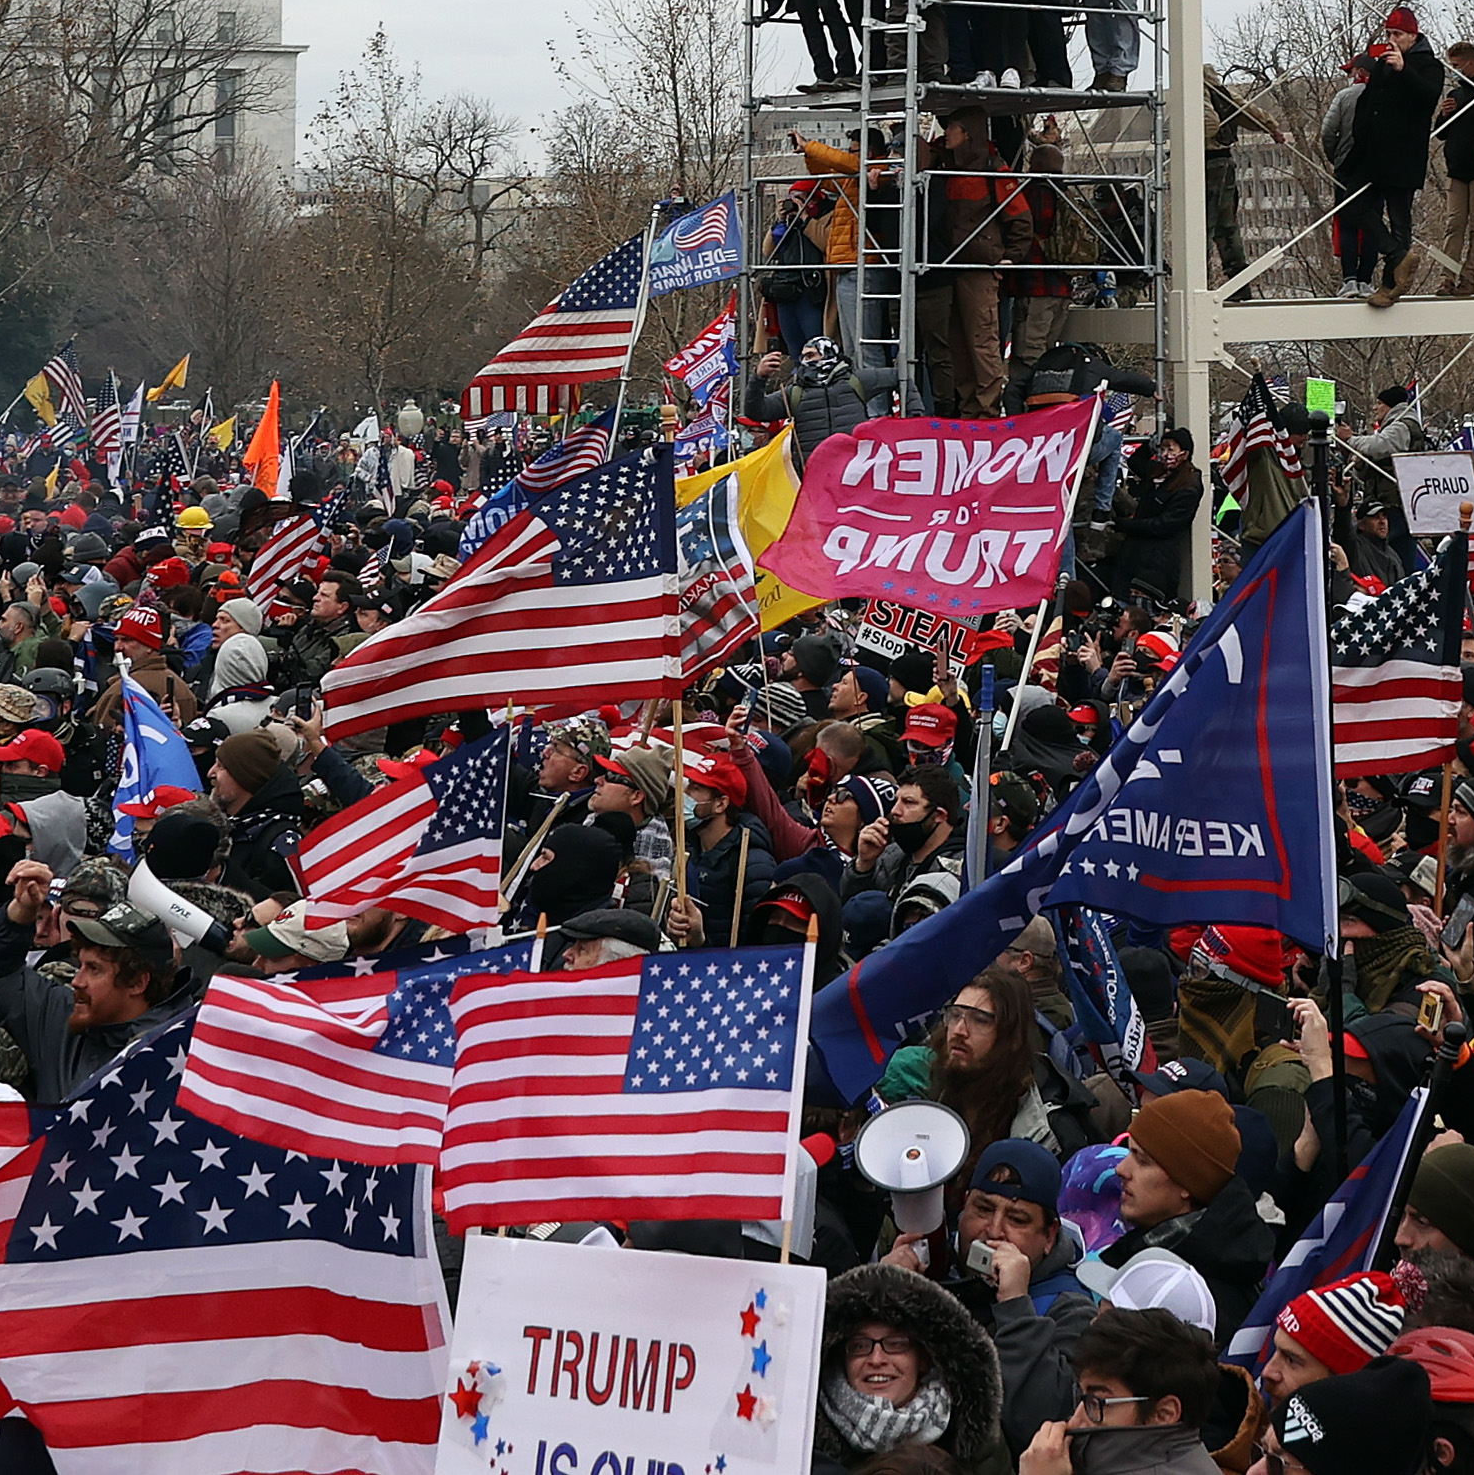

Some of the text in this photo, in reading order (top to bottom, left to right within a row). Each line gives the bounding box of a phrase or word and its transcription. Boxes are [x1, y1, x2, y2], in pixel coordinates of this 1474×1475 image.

[1423, 476, 1470, 496] FRAUD
[861, 626, 904, 656] #Stop
[868, 599, 969, 663] STEAL
[169, 903, 191, 920] PYLE
[522, 1324, 697, 1414] TRUMP
[1289, 1397, 1324, 1443] adidas
